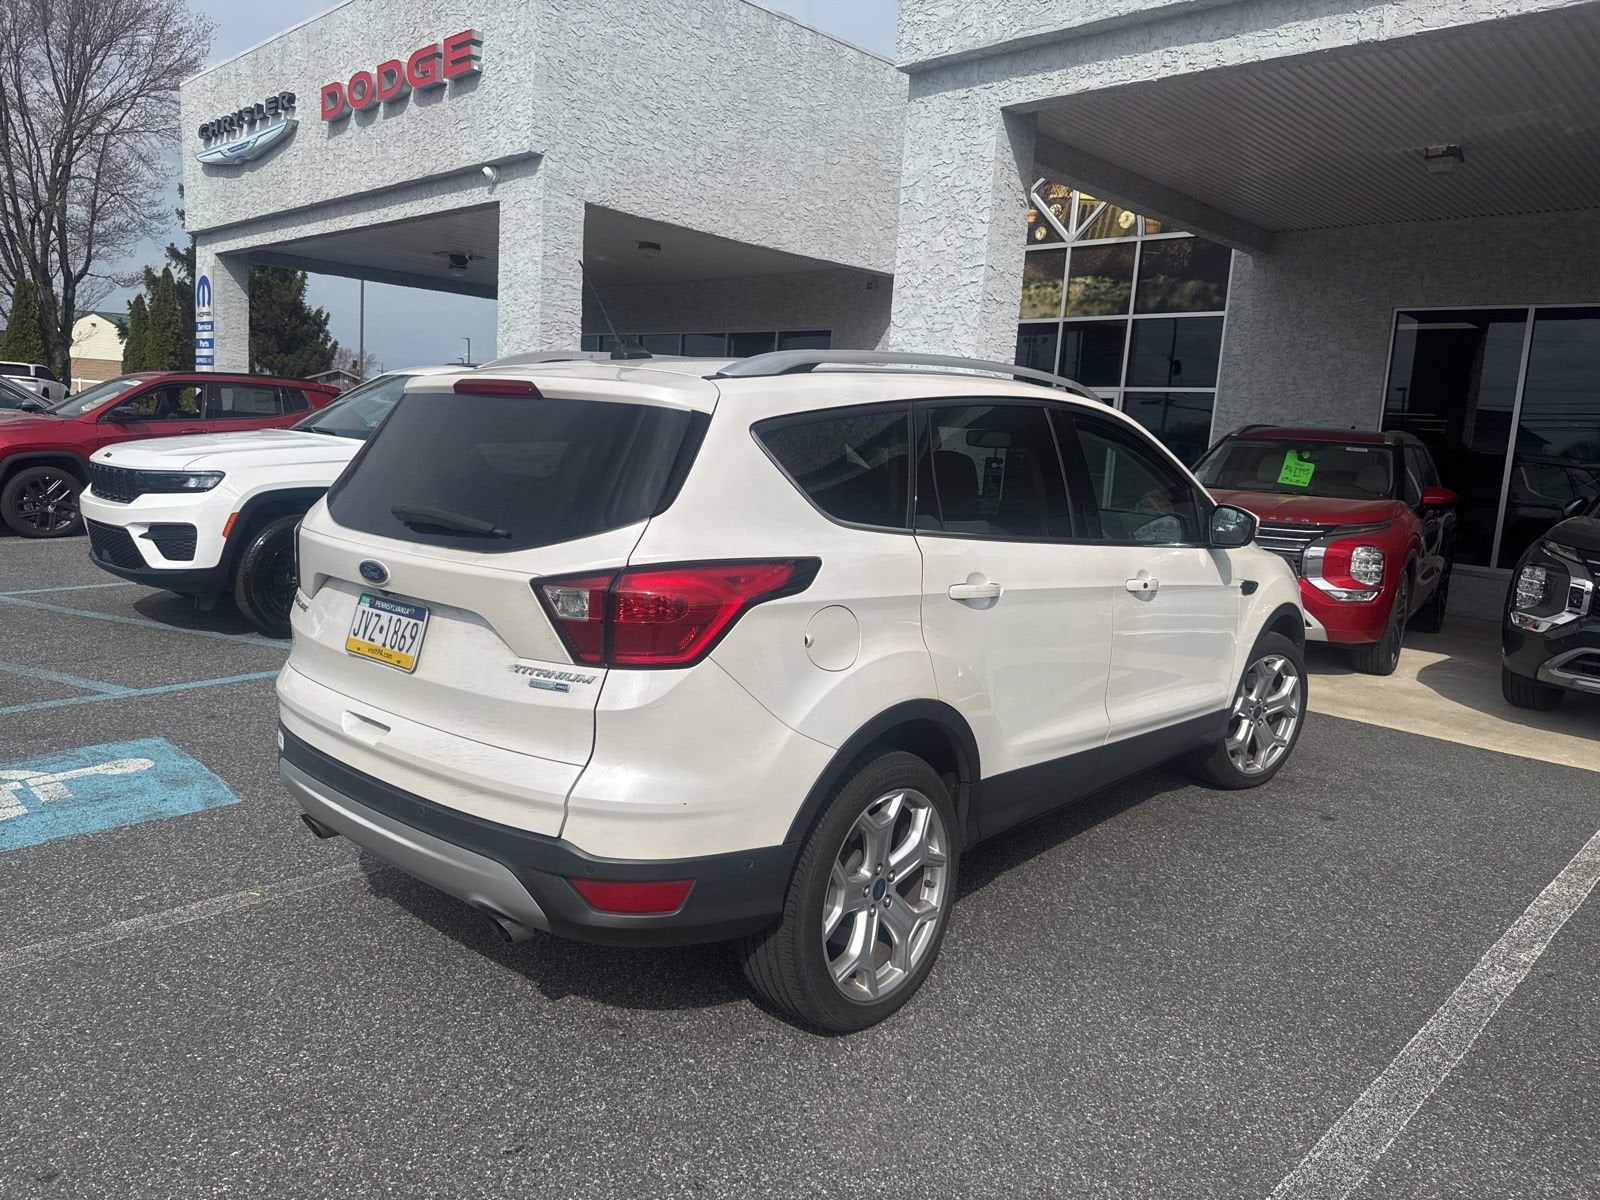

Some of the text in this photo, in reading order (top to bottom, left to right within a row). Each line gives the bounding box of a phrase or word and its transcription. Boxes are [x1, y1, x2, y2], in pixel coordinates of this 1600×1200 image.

[320, 28, 483, 122] DODGE
[198, 91, 297, 142] CHRYSLER
[374, 600, 410, 615] PENNSYLVANIA
[511, 664, 597, 685] TITANIUM
